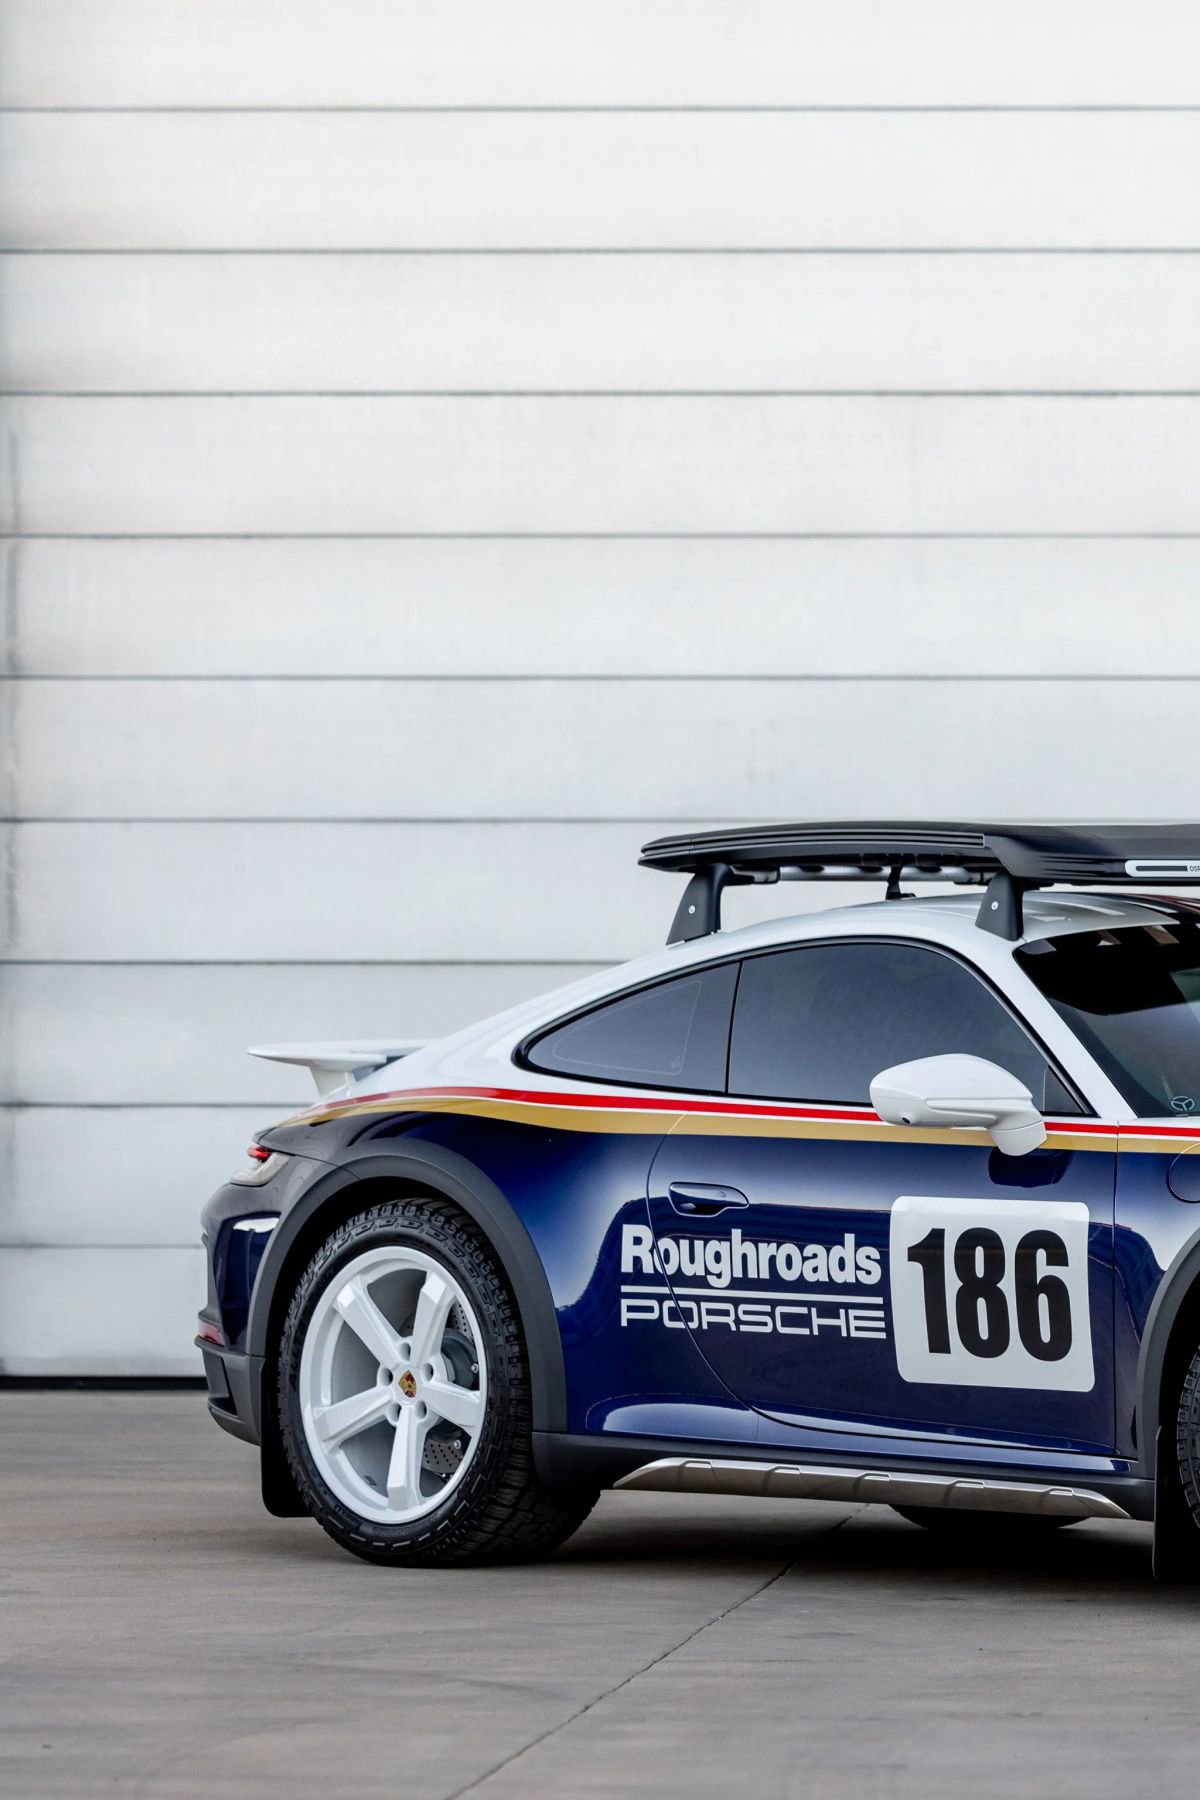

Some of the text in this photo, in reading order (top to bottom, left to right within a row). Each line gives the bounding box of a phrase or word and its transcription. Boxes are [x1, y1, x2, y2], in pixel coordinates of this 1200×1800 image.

[621, 1224, 881, 1288] Roughroads
[621, 1299, 886, 1339] PORSCHE
[908, 1227, 1072, 1362] 186
